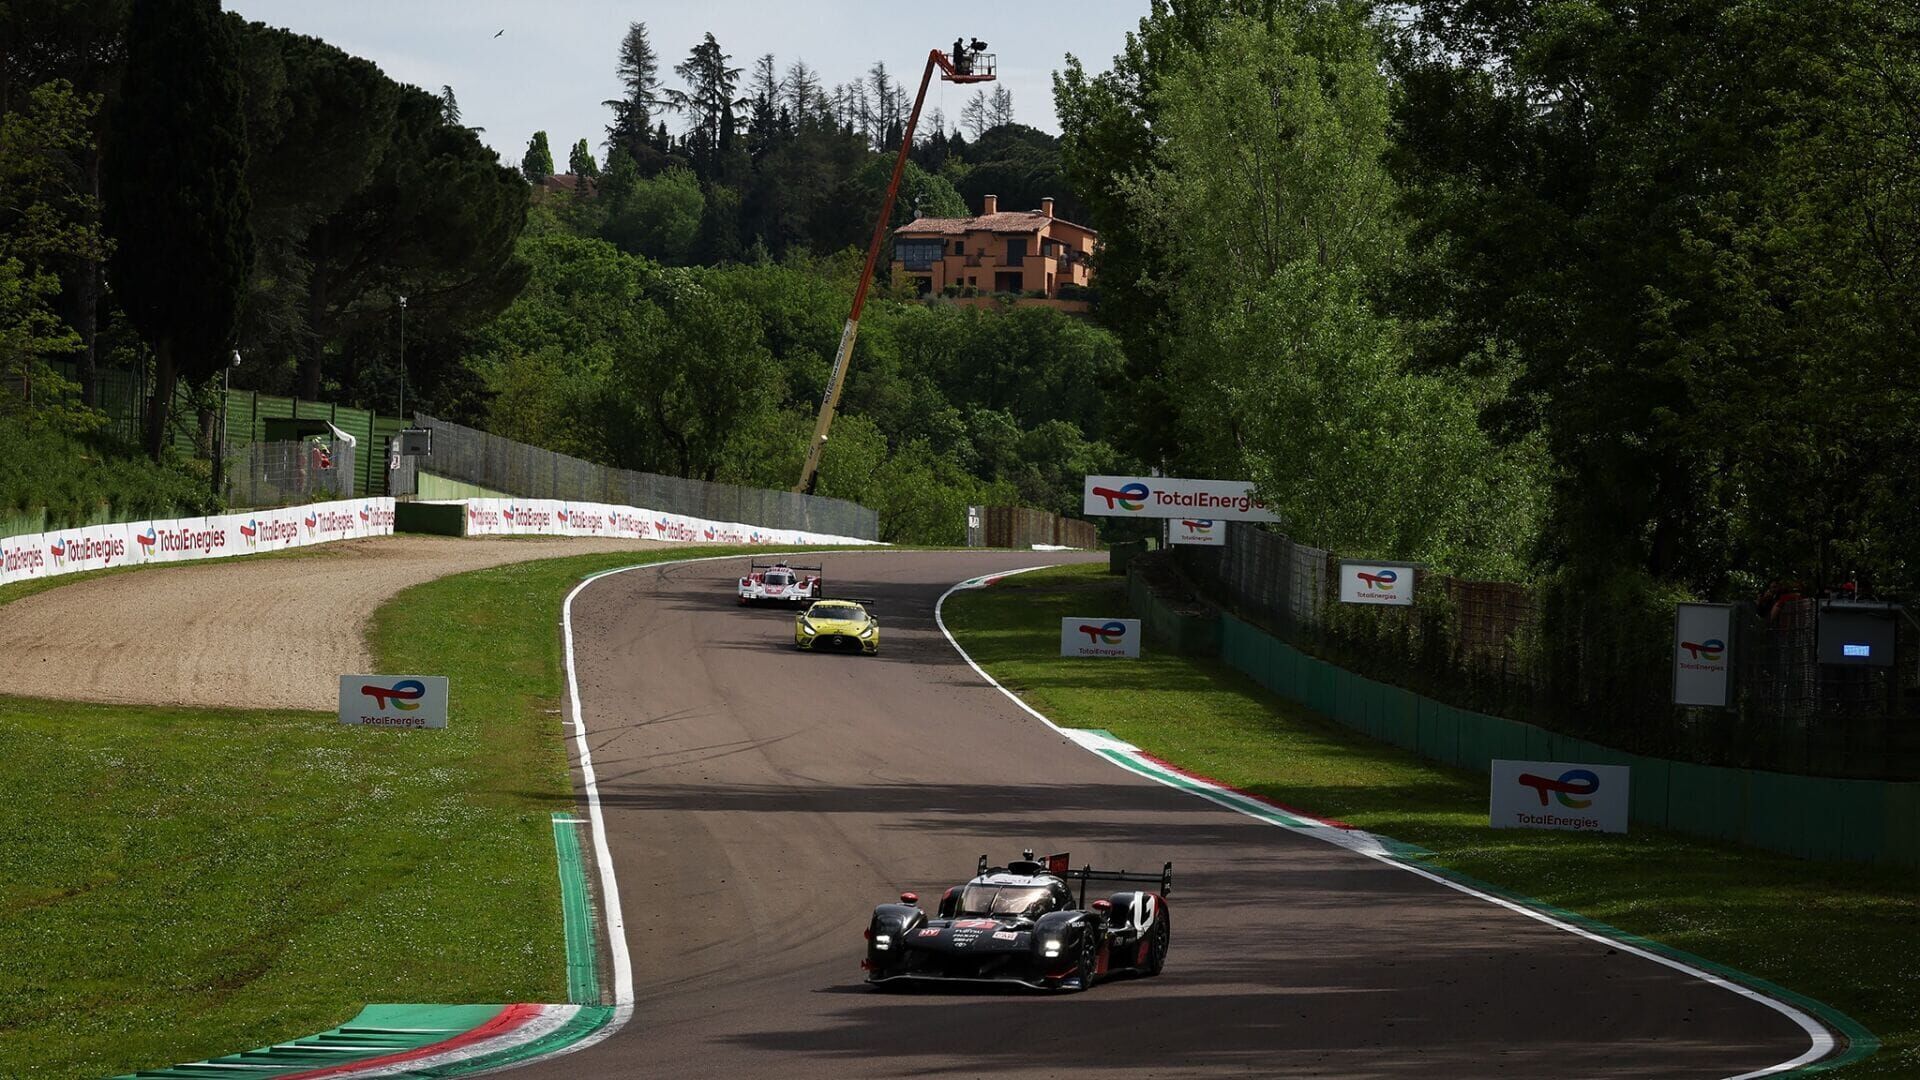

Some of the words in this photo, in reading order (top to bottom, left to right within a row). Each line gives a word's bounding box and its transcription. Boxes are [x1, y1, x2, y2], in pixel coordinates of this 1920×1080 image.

[158, 525, 226, 553] TotalEnergies
[66, 534, 125, 563] TotalEnergies
[4, 544, 44, 574] TotalEnergies
[1357, 592, 1397, 600] TotalEnergies
[1079, 647, 1125, 656] TotalEnergies
[1679, 662, 1724, 672] TotalEnergies
[361, 716, 425, 726] TotalEnergies
[1516, 813, 1599, 830] TotalEnergies
